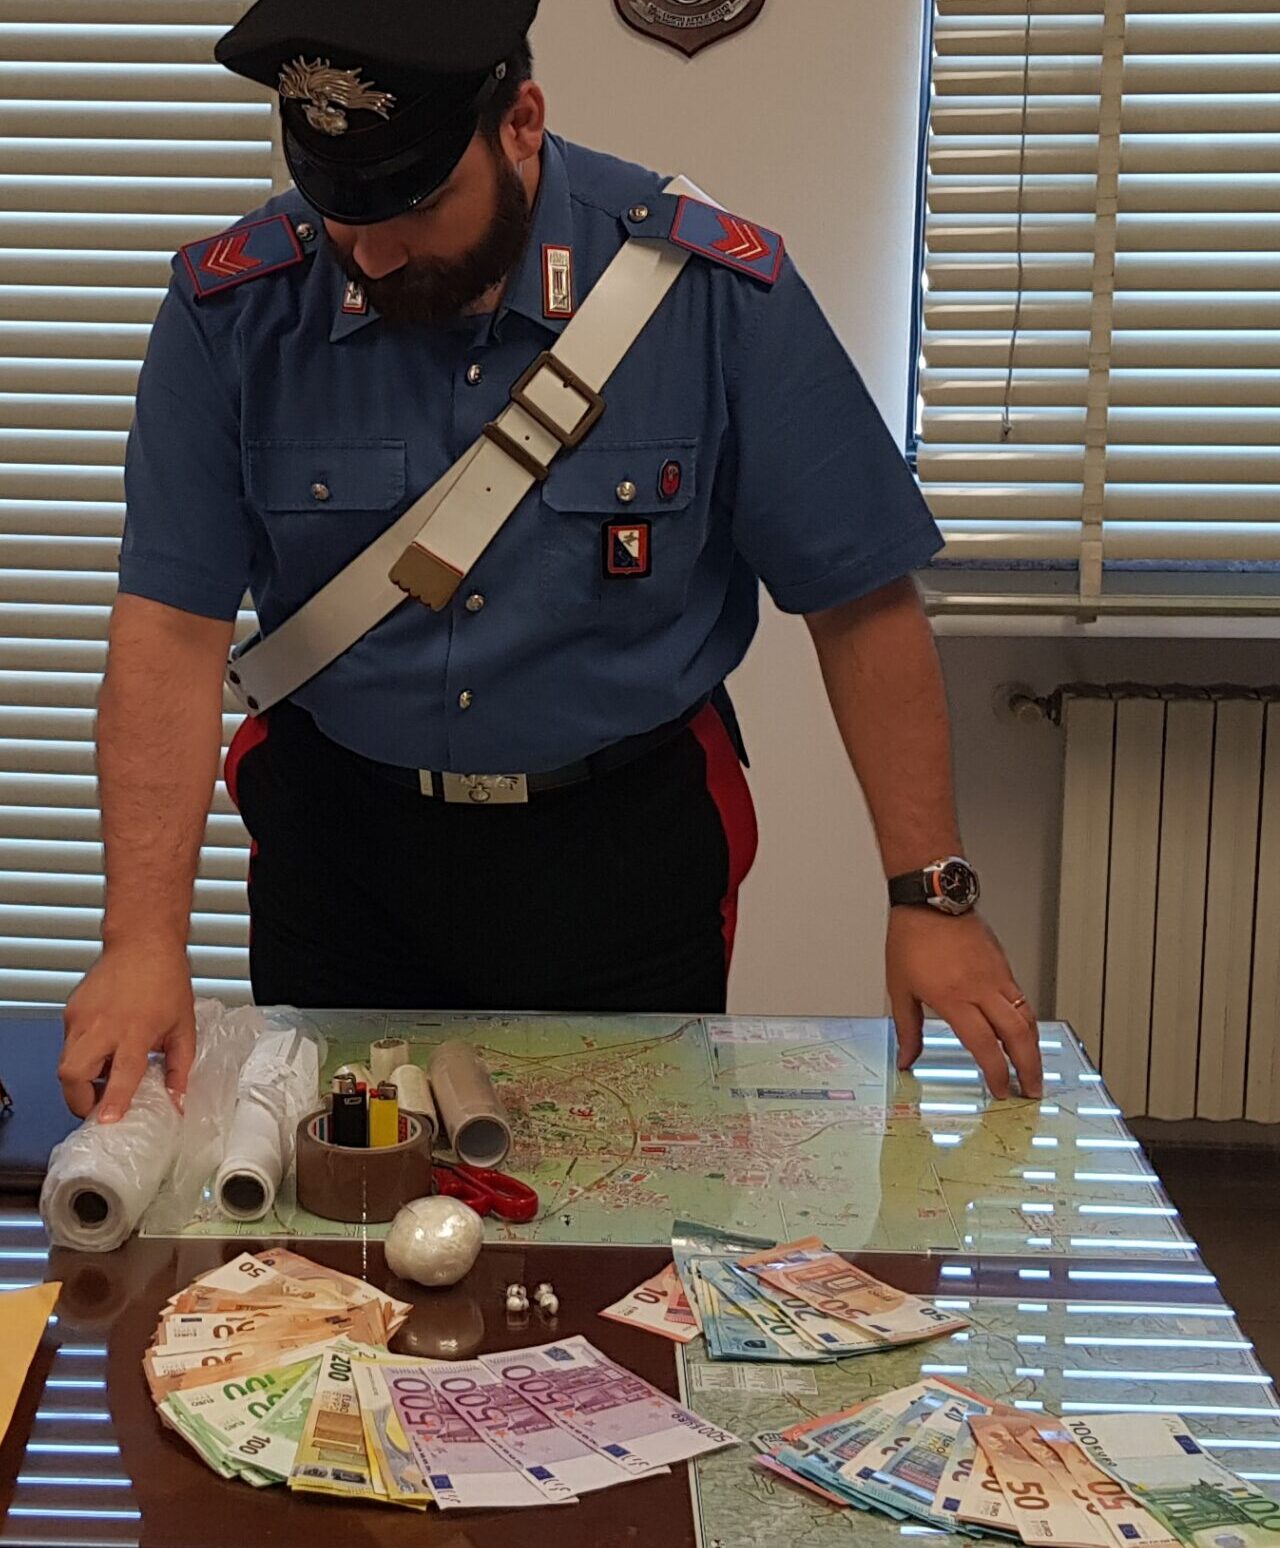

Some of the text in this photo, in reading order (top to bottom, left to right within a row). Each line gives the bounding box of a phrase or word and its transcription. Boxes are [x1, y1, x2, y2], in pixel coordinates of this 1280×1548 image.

[238, 1261, 267, 1279] 50
[633, 1285, 669, 1305] 10
[817, 1299, 871, 1320] 50
[920, 1307, 951, 1322] 50
[756, 1314, 797, 1336] 20
[328, 1354, 352, 1382] 200
[500, 1365, 572, 1406] 500
[393, 1377, 444, 1426] 500
[440, 1377, 509, 1424] 500
[671, 1413, 733, 1443] 500 EURO
[1068, 1420, 1098, 1446] 100
[239, 1435, 271, 1455] 100
[1006, 1480, 1050, 1511] 50
